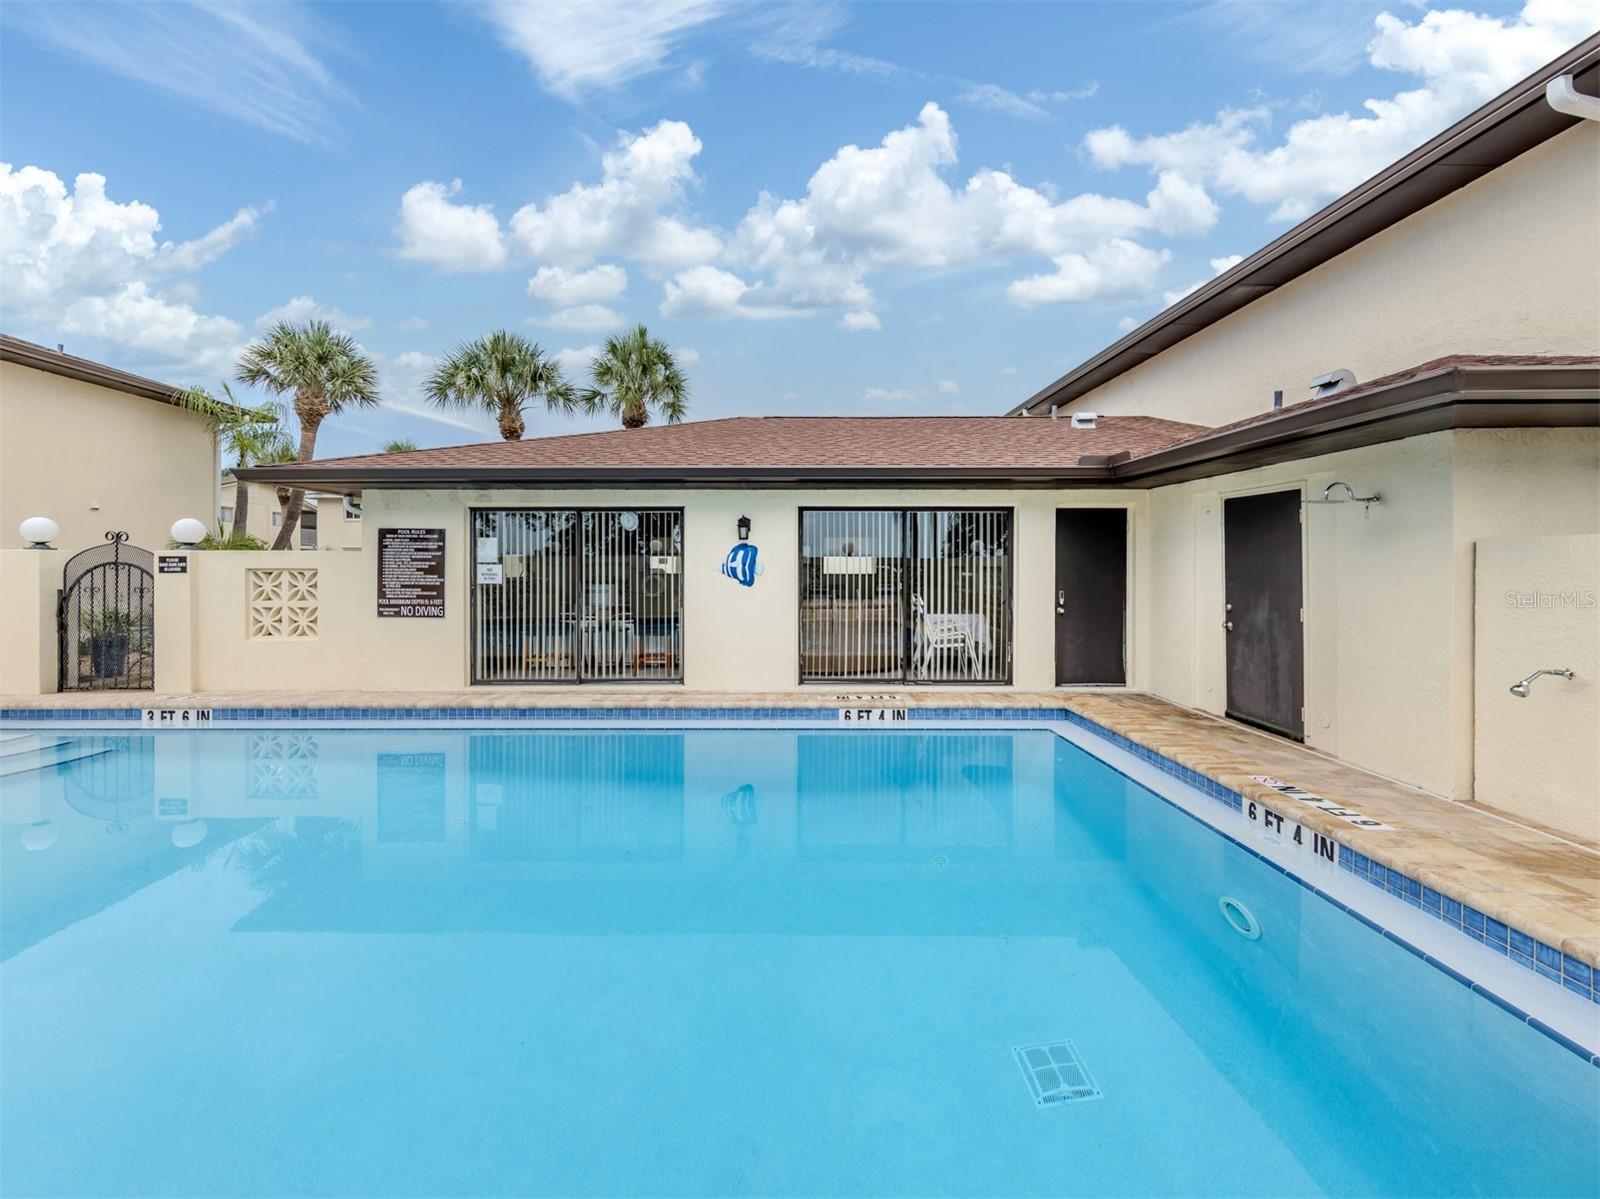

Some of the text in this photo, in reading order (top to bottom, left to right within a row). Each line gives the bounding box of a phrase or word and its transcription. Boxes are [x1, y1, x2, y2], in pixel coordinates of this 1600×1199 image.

[400, 606, 444, 616] NO DIVING
[160, 710, 176, 720] FT
[182, 710, 190, 720] 6
[196, 710, 210, 720] IN
[844, 710, 851, 720] 6
[857, 710, 872, 720] FT
[892, 710, 906, 720] IN
[1248, 802, 1335, 863] 6 FT 4 IN
